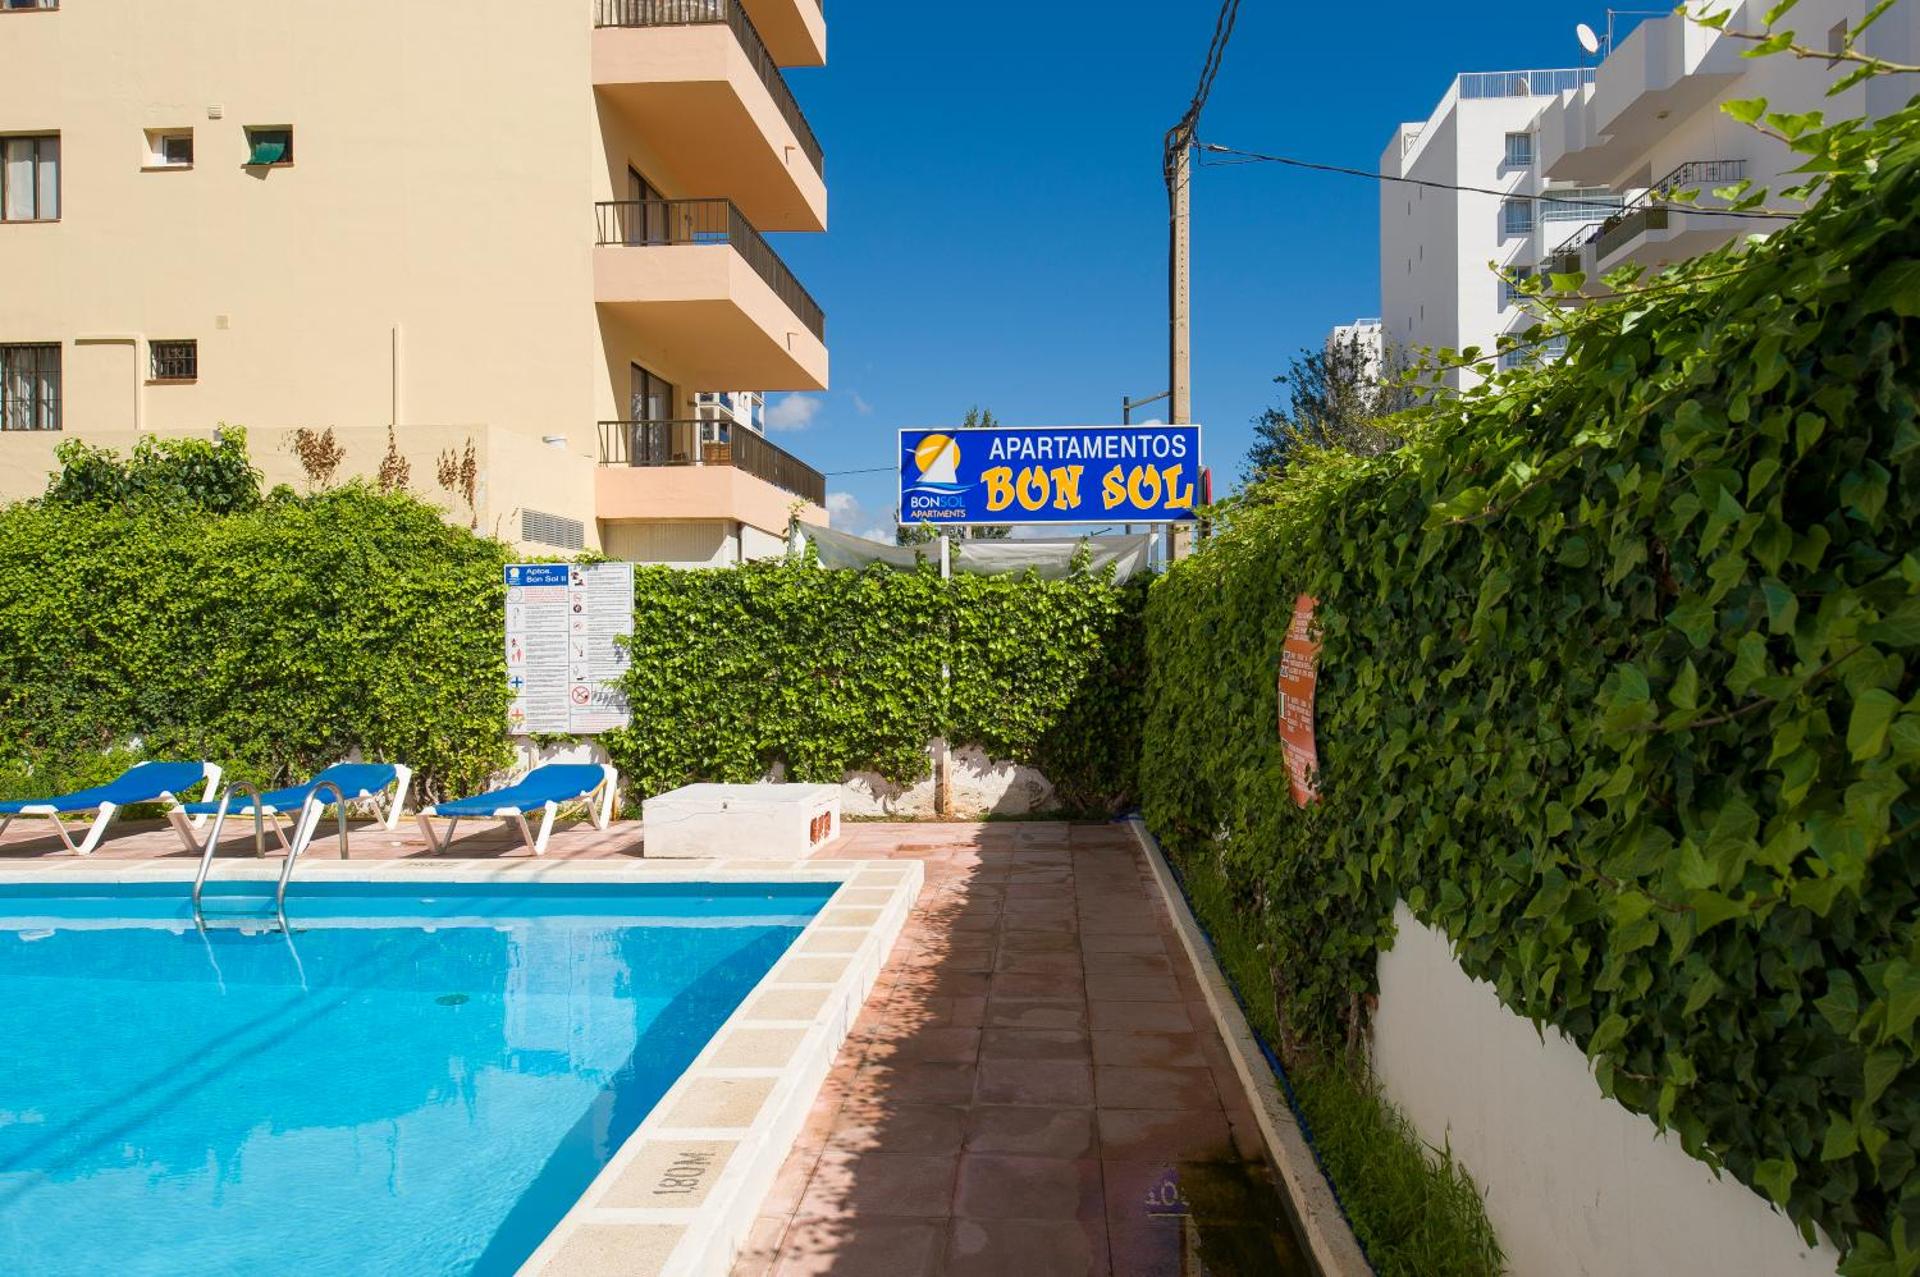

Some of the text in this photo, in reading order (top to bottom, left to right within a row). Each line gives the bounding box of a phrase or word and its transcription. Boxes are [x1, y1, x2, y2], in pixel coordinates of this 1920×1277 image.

[988, 435, 1187, 460] APARTAMENTOS
[980, 463, 1194, 511] BON SOL
[910, 496, 966, 508] BONSOL
[910, 509, 966, 519] APARTMENTS
[526, 567, 552, 576] Aptos.
[545, 575, 559, 583] Sol
